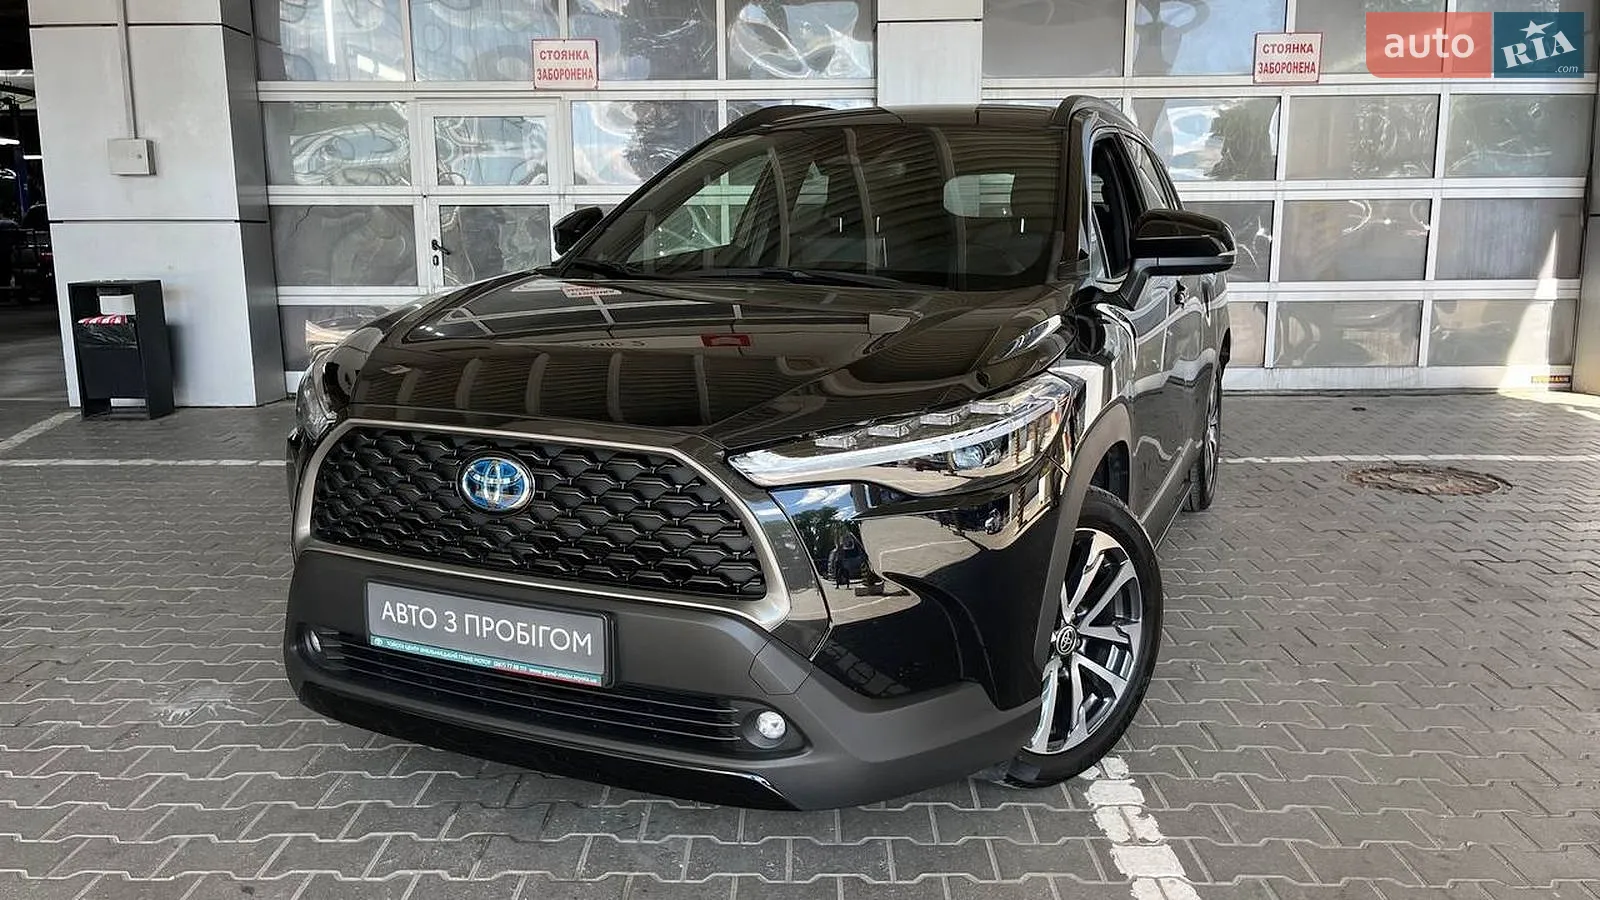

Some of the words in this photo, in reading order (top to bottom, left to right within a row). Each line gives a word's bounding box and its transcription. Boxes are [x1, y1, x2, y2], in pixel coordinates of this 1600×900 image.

[539, 50, 590, 60] СТОЯНКА
[1262, 43, 1314, 54] СТОЯНКА
[1258, 61, 1316, 74] ЗАБОРОНЕНА
[536, 68, 594, 81] ЗАБОРОНЕНА
[381, 600, 438, 630] АВТО
[464, 613, 593, 657] ПРОБІГОМ
